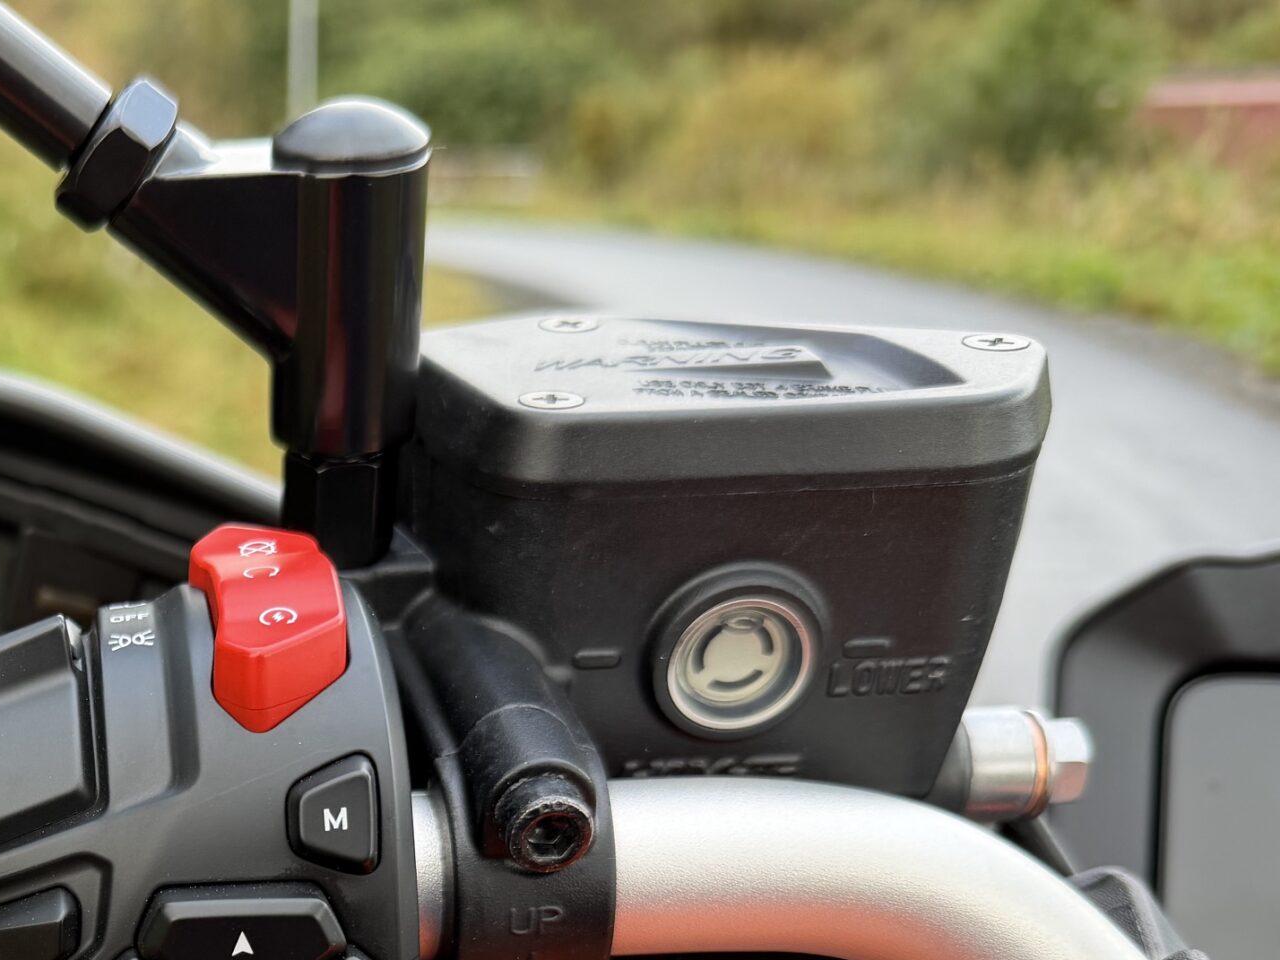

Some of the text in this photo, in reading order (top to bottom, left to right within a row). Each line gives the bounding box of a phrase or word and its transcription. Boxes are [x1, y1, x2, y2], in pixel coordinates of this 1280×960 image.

[534, 347, 803, 372] WARNING
[110, 612, 149, 623] OFF
[826, 656, 952, 698] LOWER
[323, 806, 348, 832] M
[509, 905, 563, 934] UP
